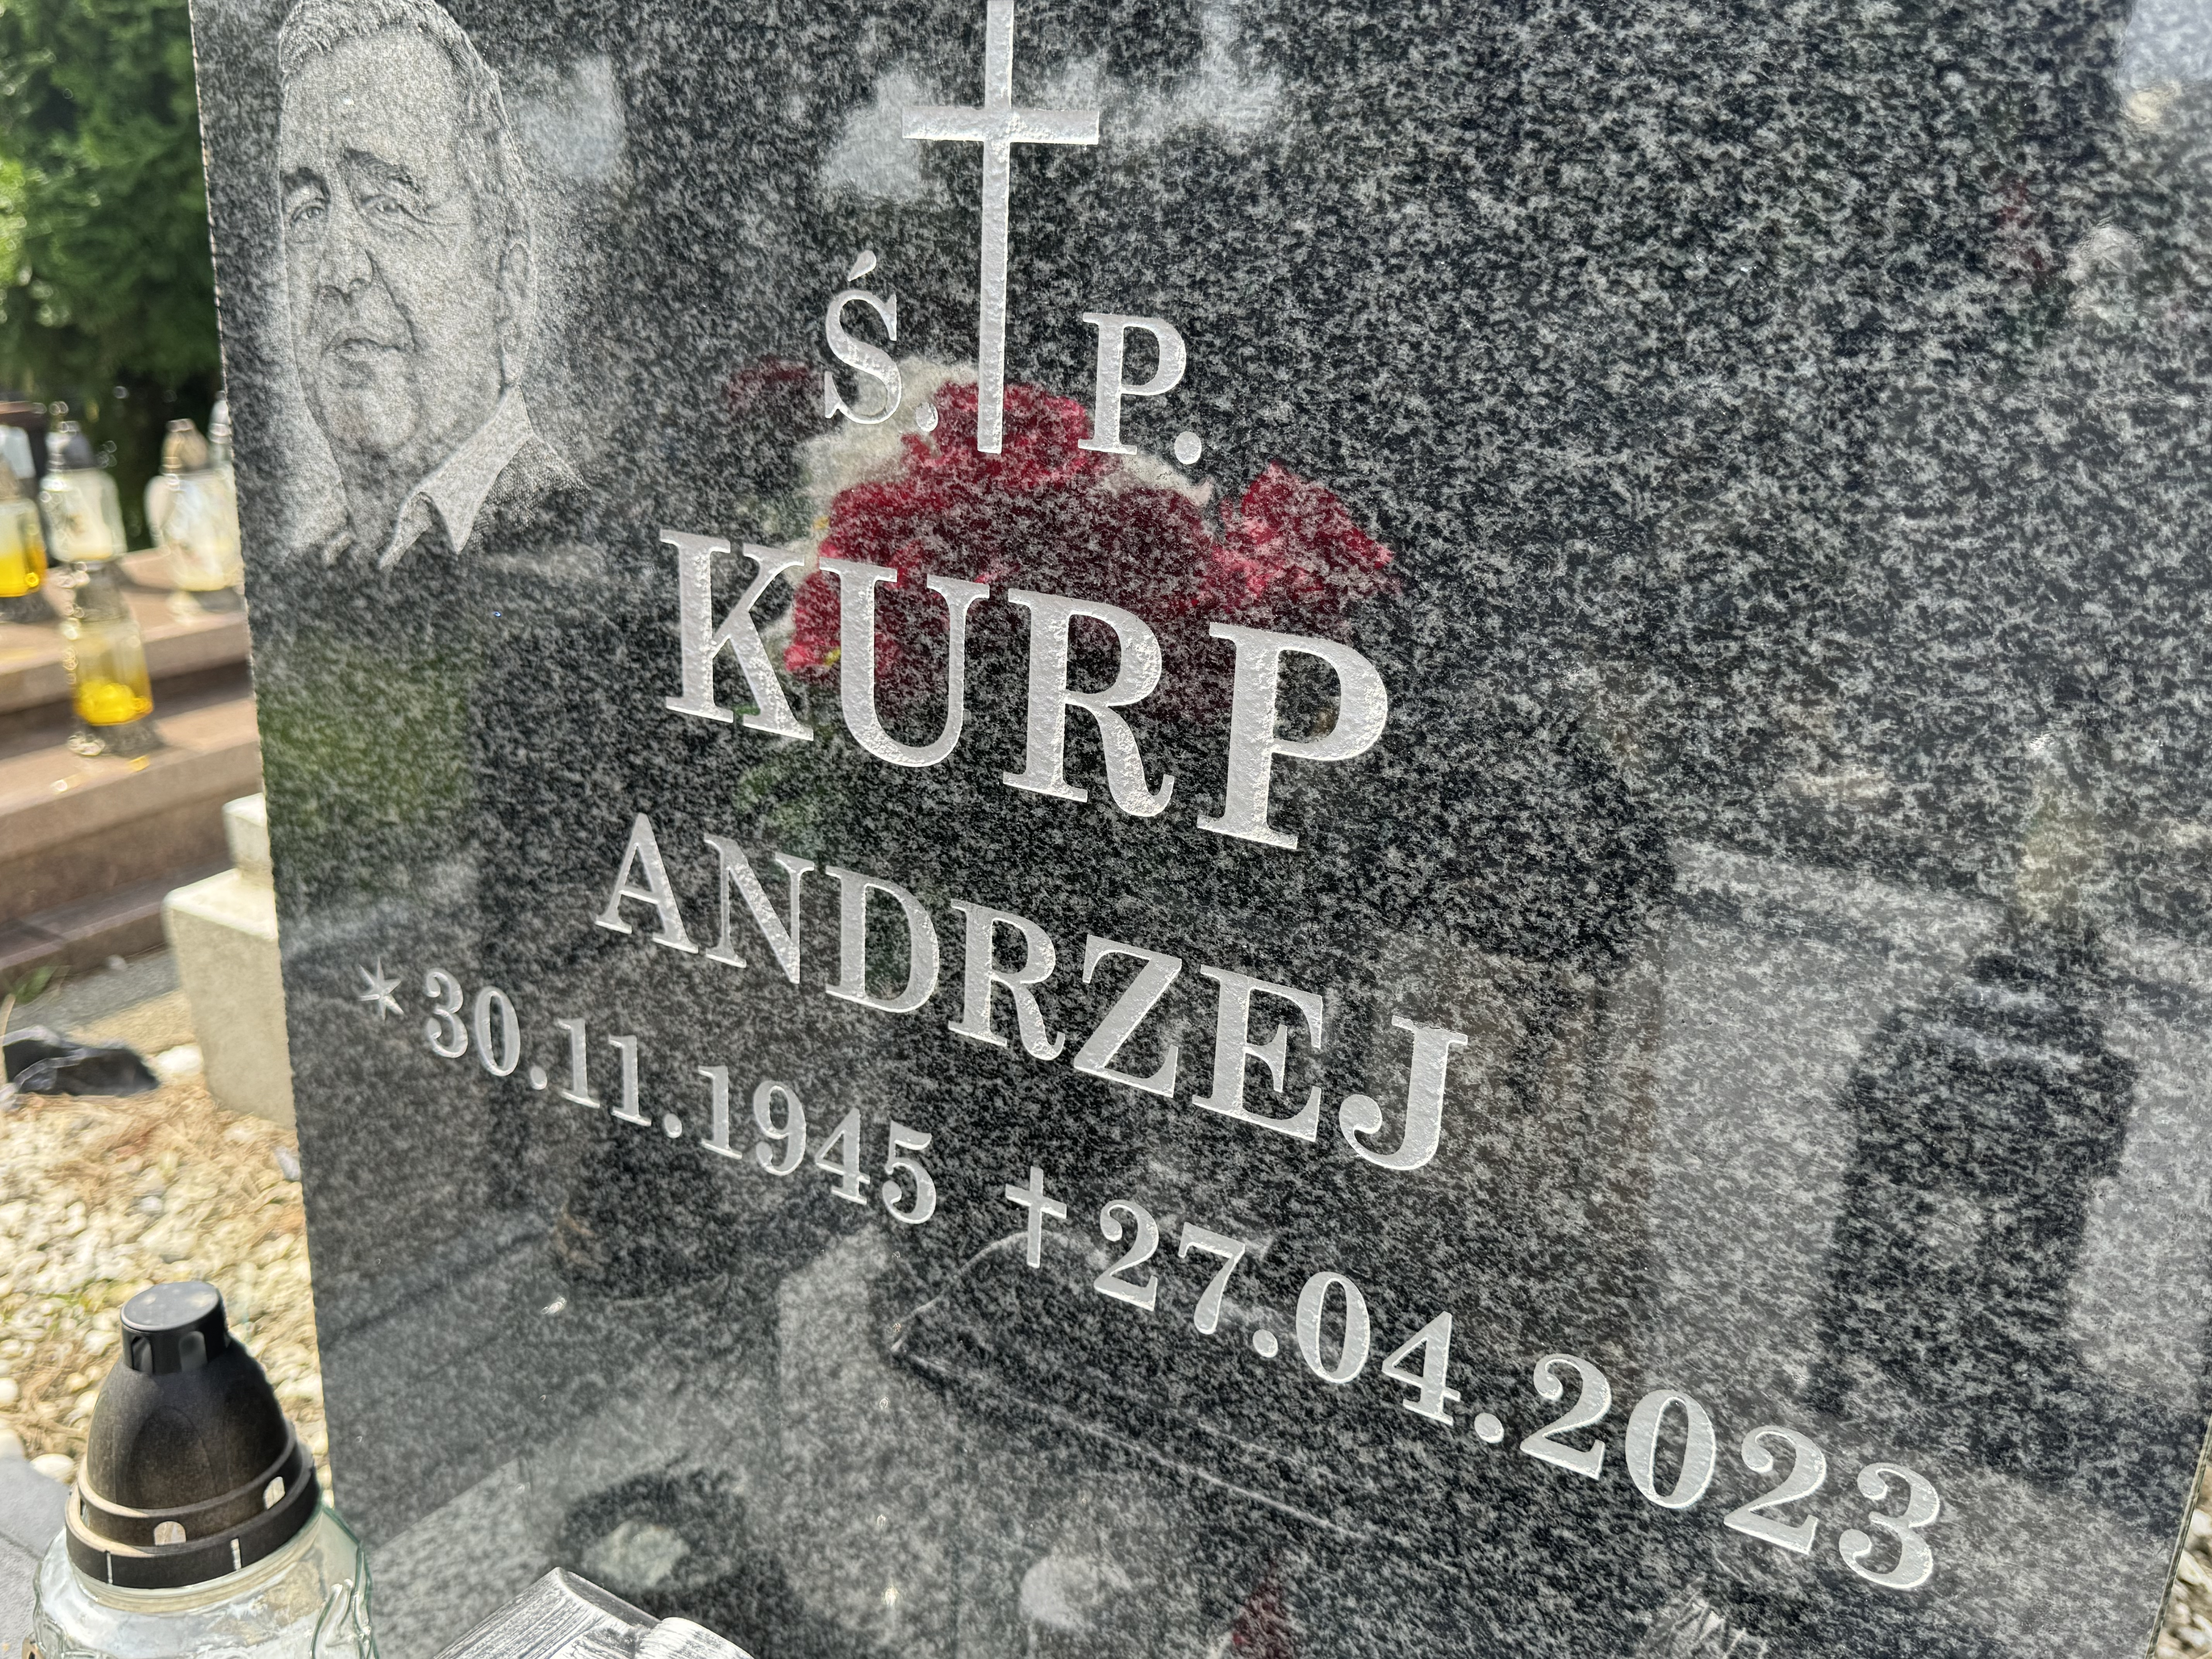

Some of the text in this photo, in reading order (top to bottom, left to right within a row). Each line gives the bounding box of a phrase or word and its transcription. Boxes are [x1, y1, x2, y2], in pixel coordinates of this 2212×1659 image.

[824, 250, 1202, 465] Ś. P.
[661, 530, 1389, 850] KURP
[595, 813, 1468, 1171] ANDRZEJ
[425, 969, 1940, 1591] 30.11.1945 27.04.2023
